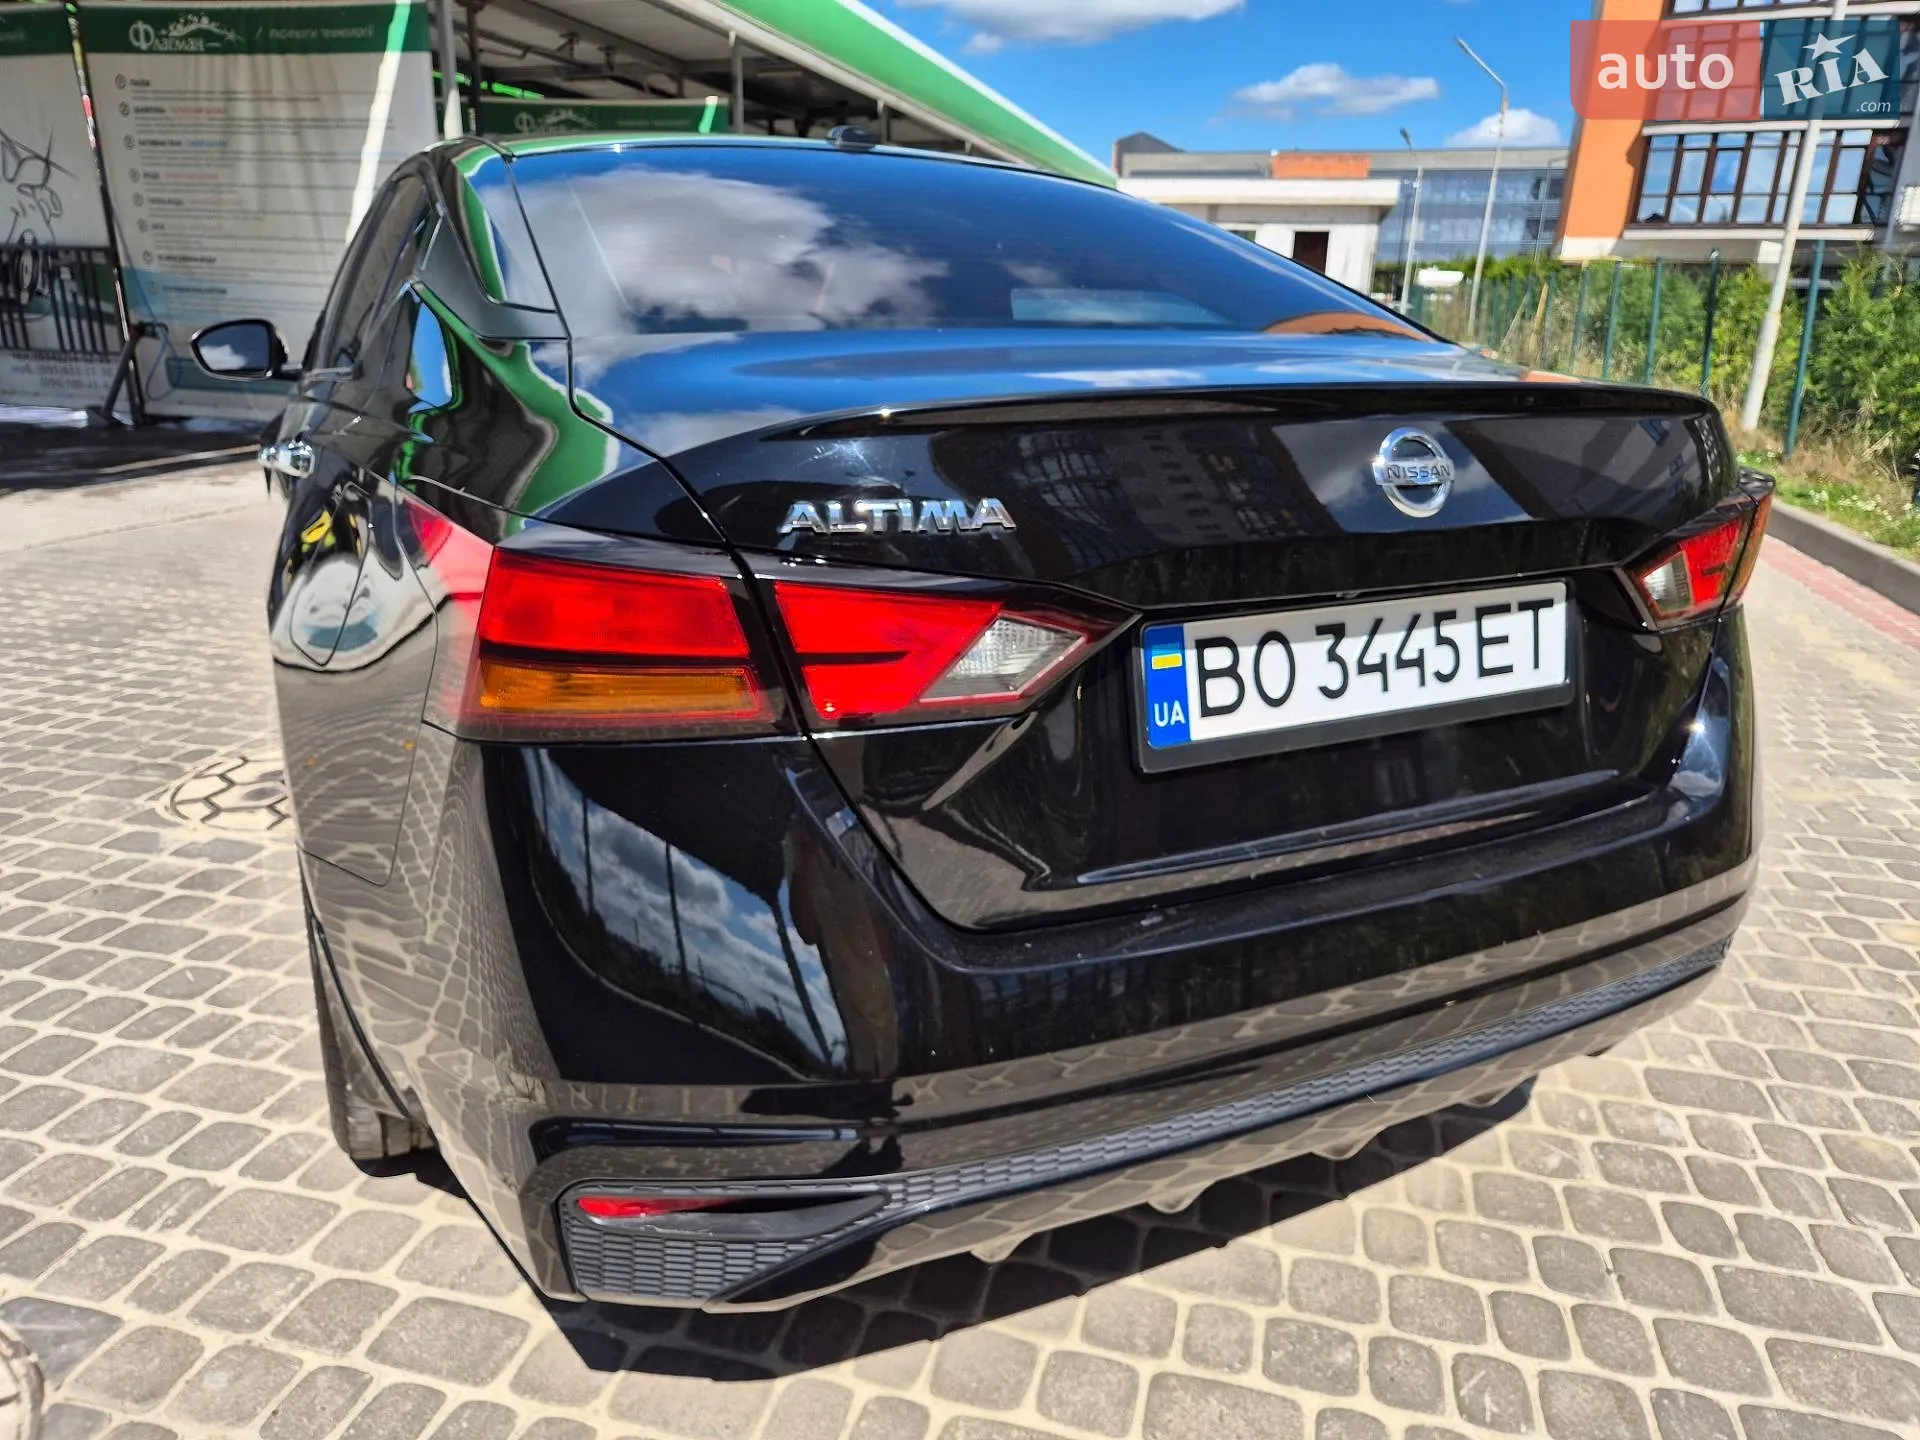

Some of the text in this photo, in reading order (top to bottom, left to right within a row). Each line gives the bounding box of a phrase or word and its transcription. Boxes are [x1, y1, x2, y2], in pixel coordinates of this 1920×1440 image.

[1387, 463, 1451, 480] NISSAN
[778, 497, 1017, 536] ALTIMA
[1194, 597, 1555, 719] BO 3445 ET
[1153, 700, 1187, 729] UA
